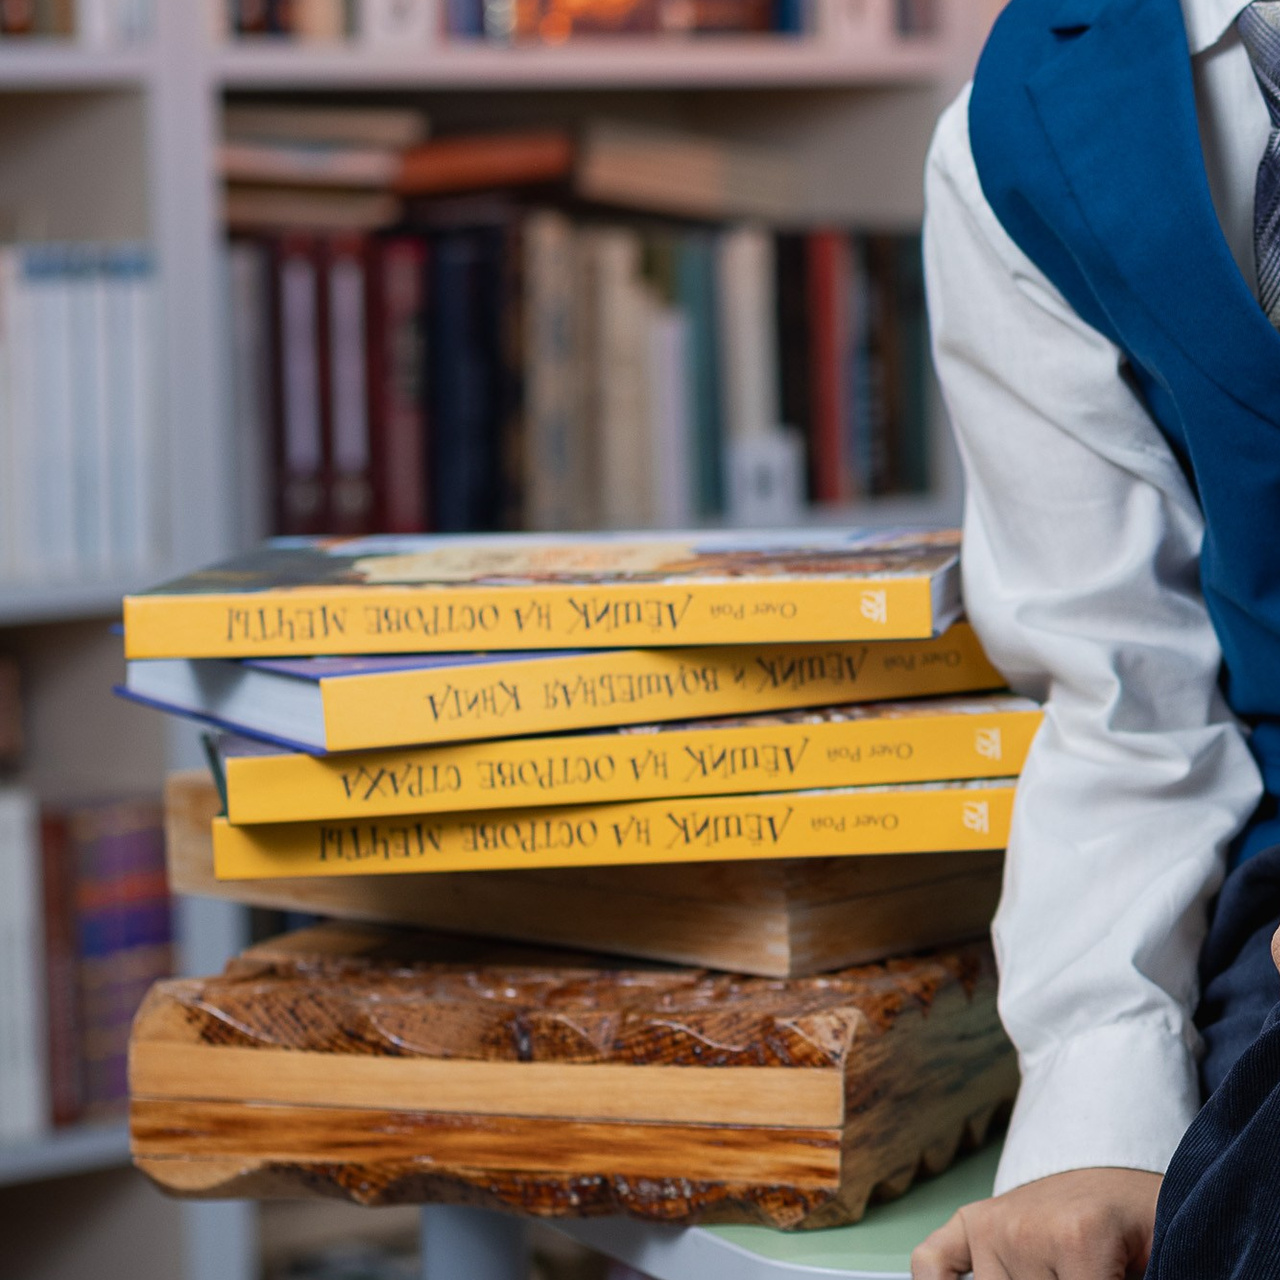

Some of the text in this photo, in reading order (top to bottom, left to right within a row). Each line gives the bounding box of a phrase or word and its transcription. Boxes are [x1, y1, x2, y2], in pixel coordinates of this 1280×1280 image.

[224, 593, 692, 642] ЛЁШИК НА ОСТРОВЕ МЕЧТЫ
[709, 601, 796, 620] Олег Рой
[422, 679, 519, 723] КНИГА
[543, 663, 718, 709] ВОЛШЕБНАЯ
[339, 736, 808, 800] ЛЁШИК НА ОСТРОВЕ СТРАХА
[825, 742, 912, 763] Олег Рой
[317, 806, 793, 861] ЛЁШИК НА ОСТРОВЕ МЕЧТЫ
[809, 812, 898, 833] Олег Рой
